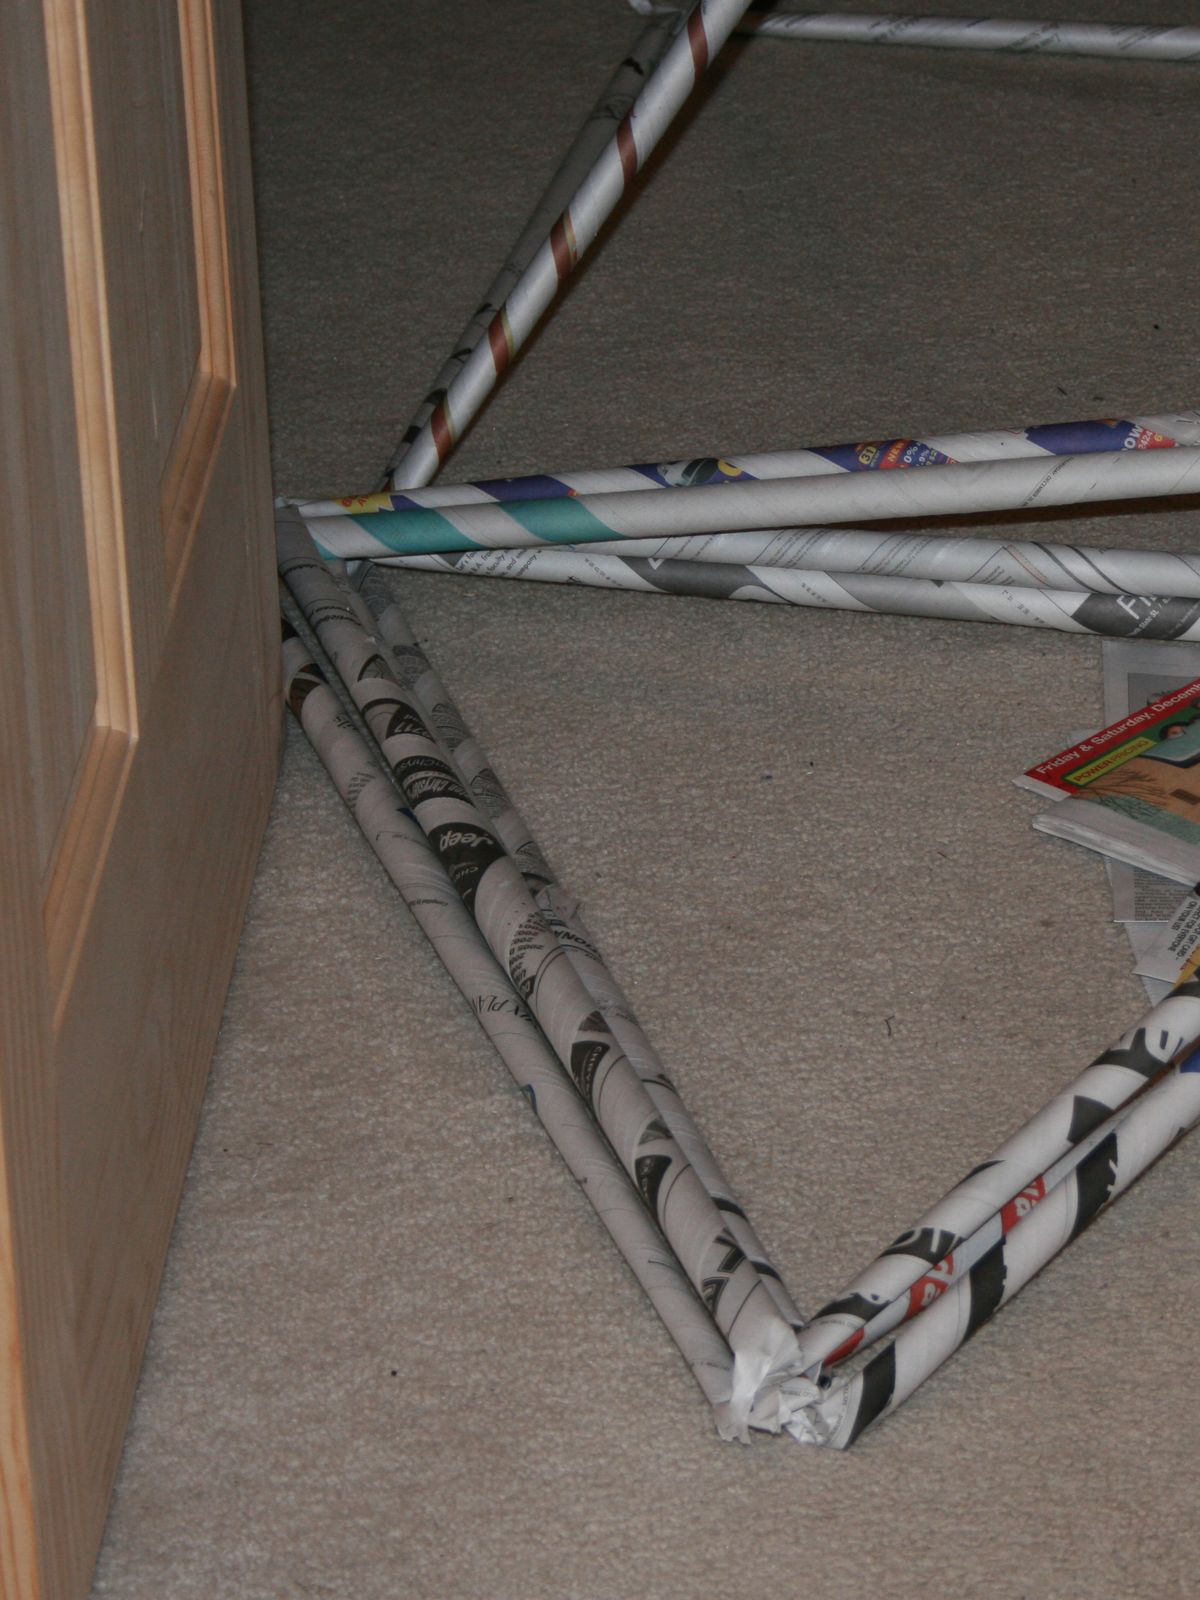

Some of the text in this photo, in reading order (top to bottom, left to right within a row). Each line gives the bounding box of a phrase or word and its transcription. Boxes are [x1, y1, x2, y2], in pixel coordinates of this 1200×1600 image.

[1037, 750, 1079, 775] Friday
[1080, 743, 1093, 753] &
[1092, 709, 1154, 746] Saturday,
[440, 829, 494, 853] Jeep
